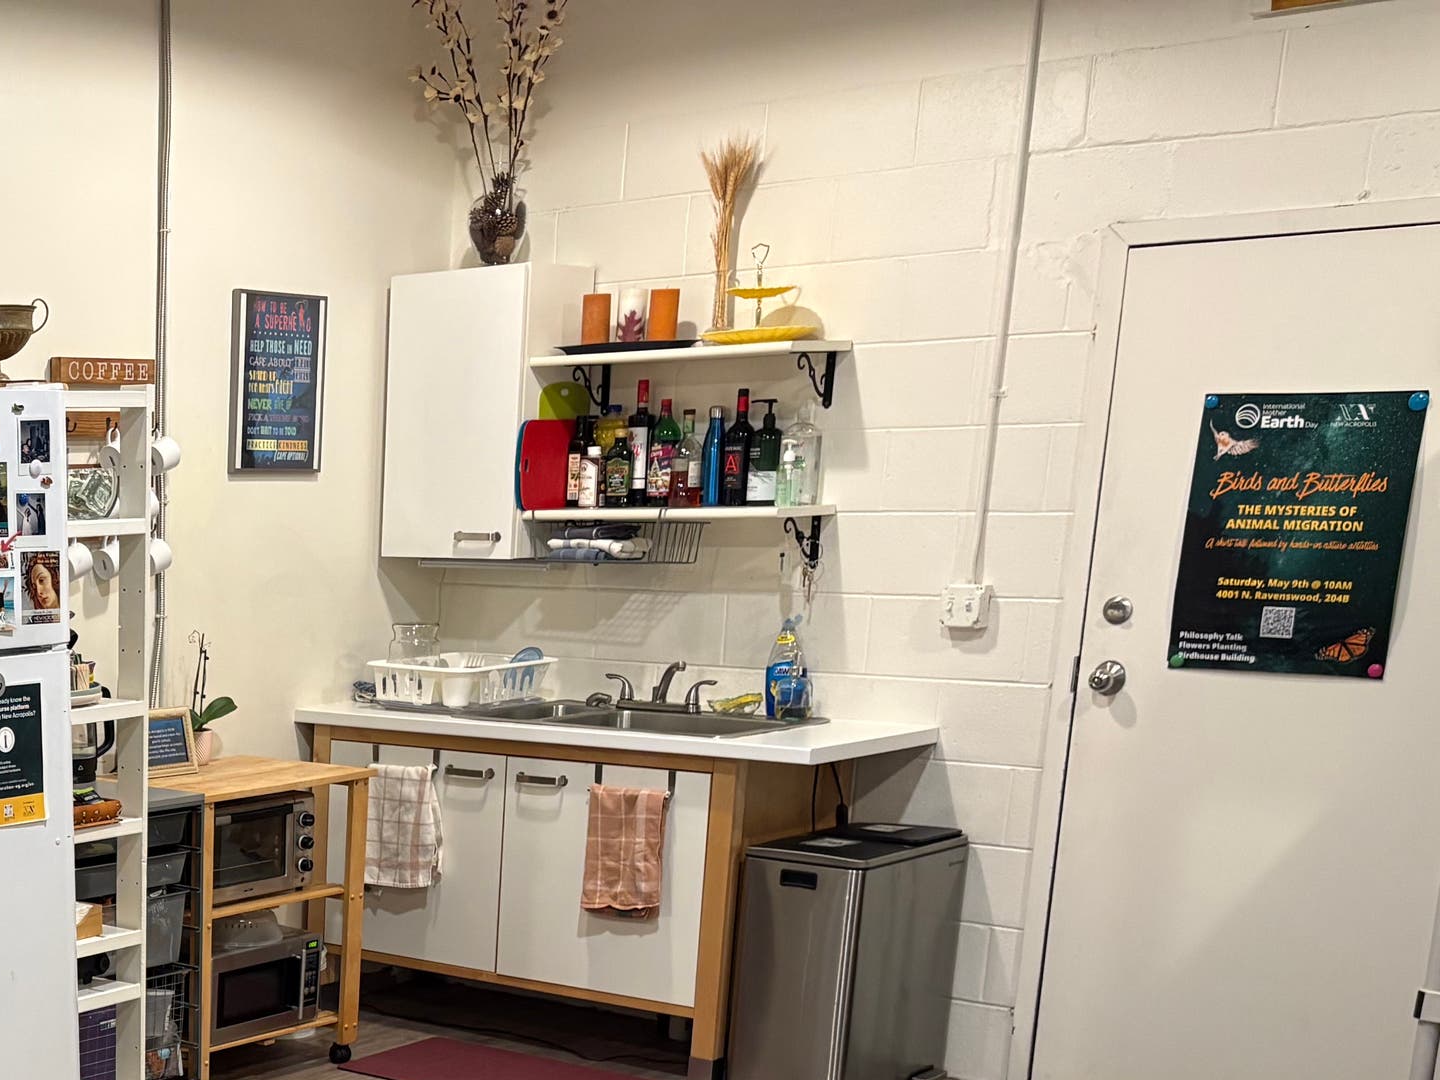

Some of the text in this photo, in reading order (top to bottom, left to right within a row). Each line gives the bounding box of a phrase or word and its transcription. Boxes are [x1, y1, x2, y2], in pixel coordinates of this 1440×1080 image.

[250, 340, 264, 352] HELP
[266, 340, 285, 353] THOSE
[294, 340, 312, 355] NEED
[68, 361, 148, 380] COFFEE
[247, 399, 272, 410] NEVER
[1262, 402, 1306, 410] International
[1262, 409, 1286, 417] Mother
[1260, 415, 1319, 430] Earth Day
[1210, 471, 1388, 500] Birds and Butterflies
[1237, 504, 1358, 517] THE MYSTERIES OF
[1225, 519, 1364, 532] ANIMAL MIGRATION
[1217, 577, 1265, 588] Saturday,
[1267, 578, 1292, 590] May
[1291, 579, 1309, 589] 9th
[1324, 580, 1352, 590] 10AM
[1216, 589, 1350, 603] 4001 N. Ravenswood, 204B
[1179, 631, 1244, 641] Philosophy Talk
[1179, 641, 1247, 652] Flowers Planting
[1220, 653, 1256, 663] Building
